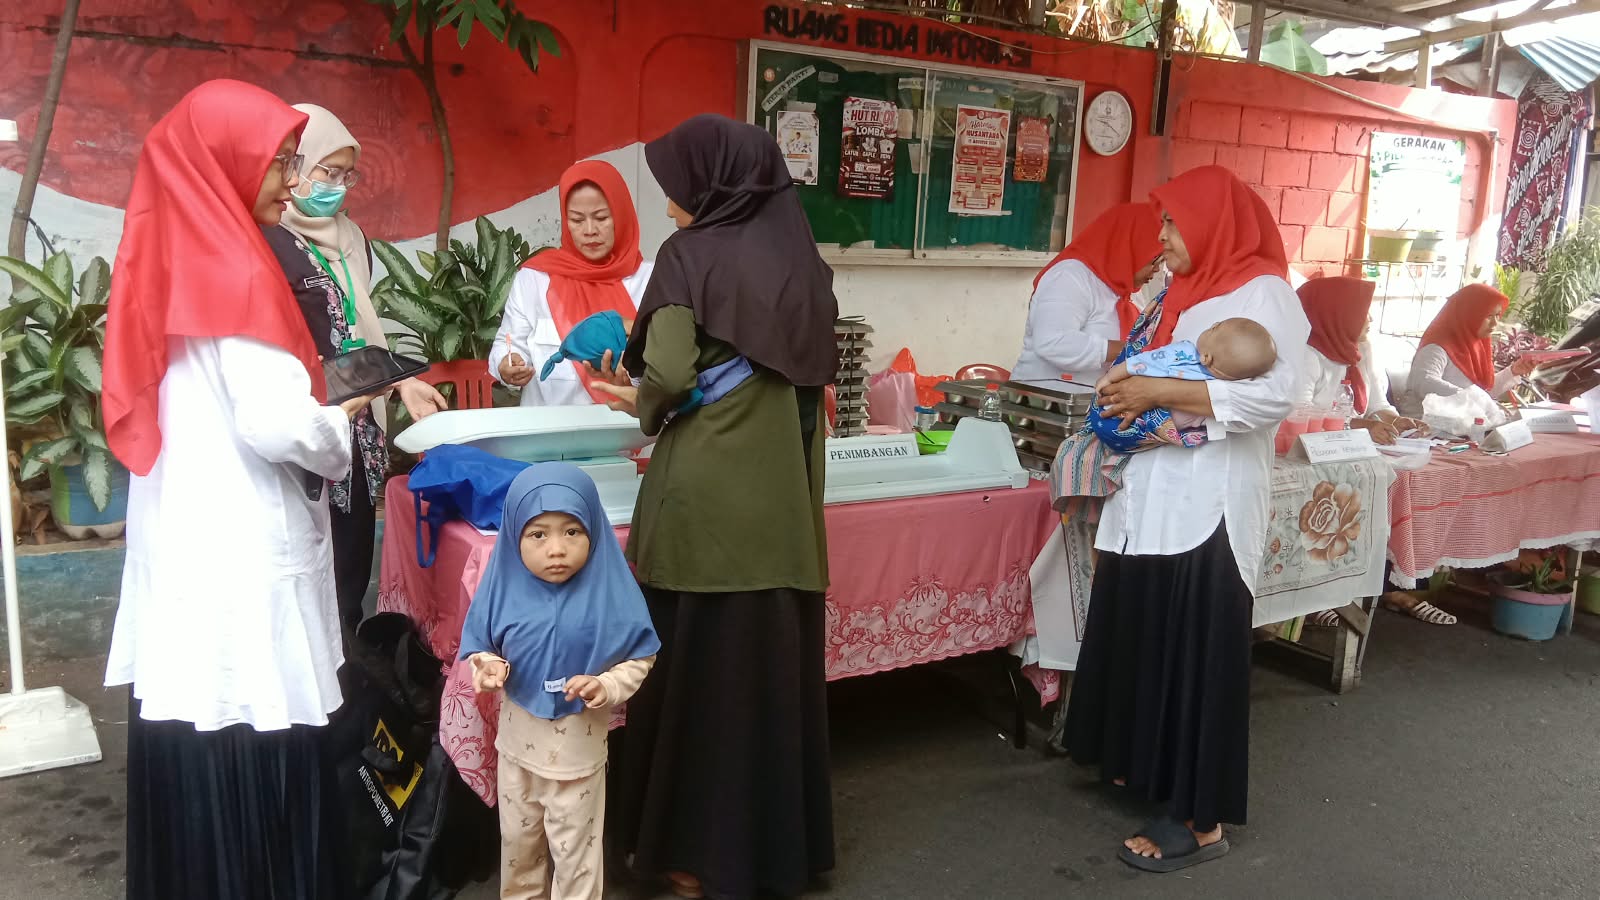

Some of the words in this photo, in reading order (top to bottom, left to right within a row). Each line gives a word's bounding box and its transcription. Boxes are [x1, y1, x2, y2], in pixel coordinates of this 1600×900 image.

[764, 5, 849, 46] RUANG
[856, 17, 919, 54] MEDIA
[851, 109, 869, 121] HUT
[870, 110, 880, 122] RI
[856, 126, 886, 138] LOMBA
[1393, 137, 1446, 151] GERAKAN
[830, 446, 908, 460] PENIMBANGAN
[358, 765, 390, 818] ANTROPOMETRI
[383, 812, 394, 828] KIT
